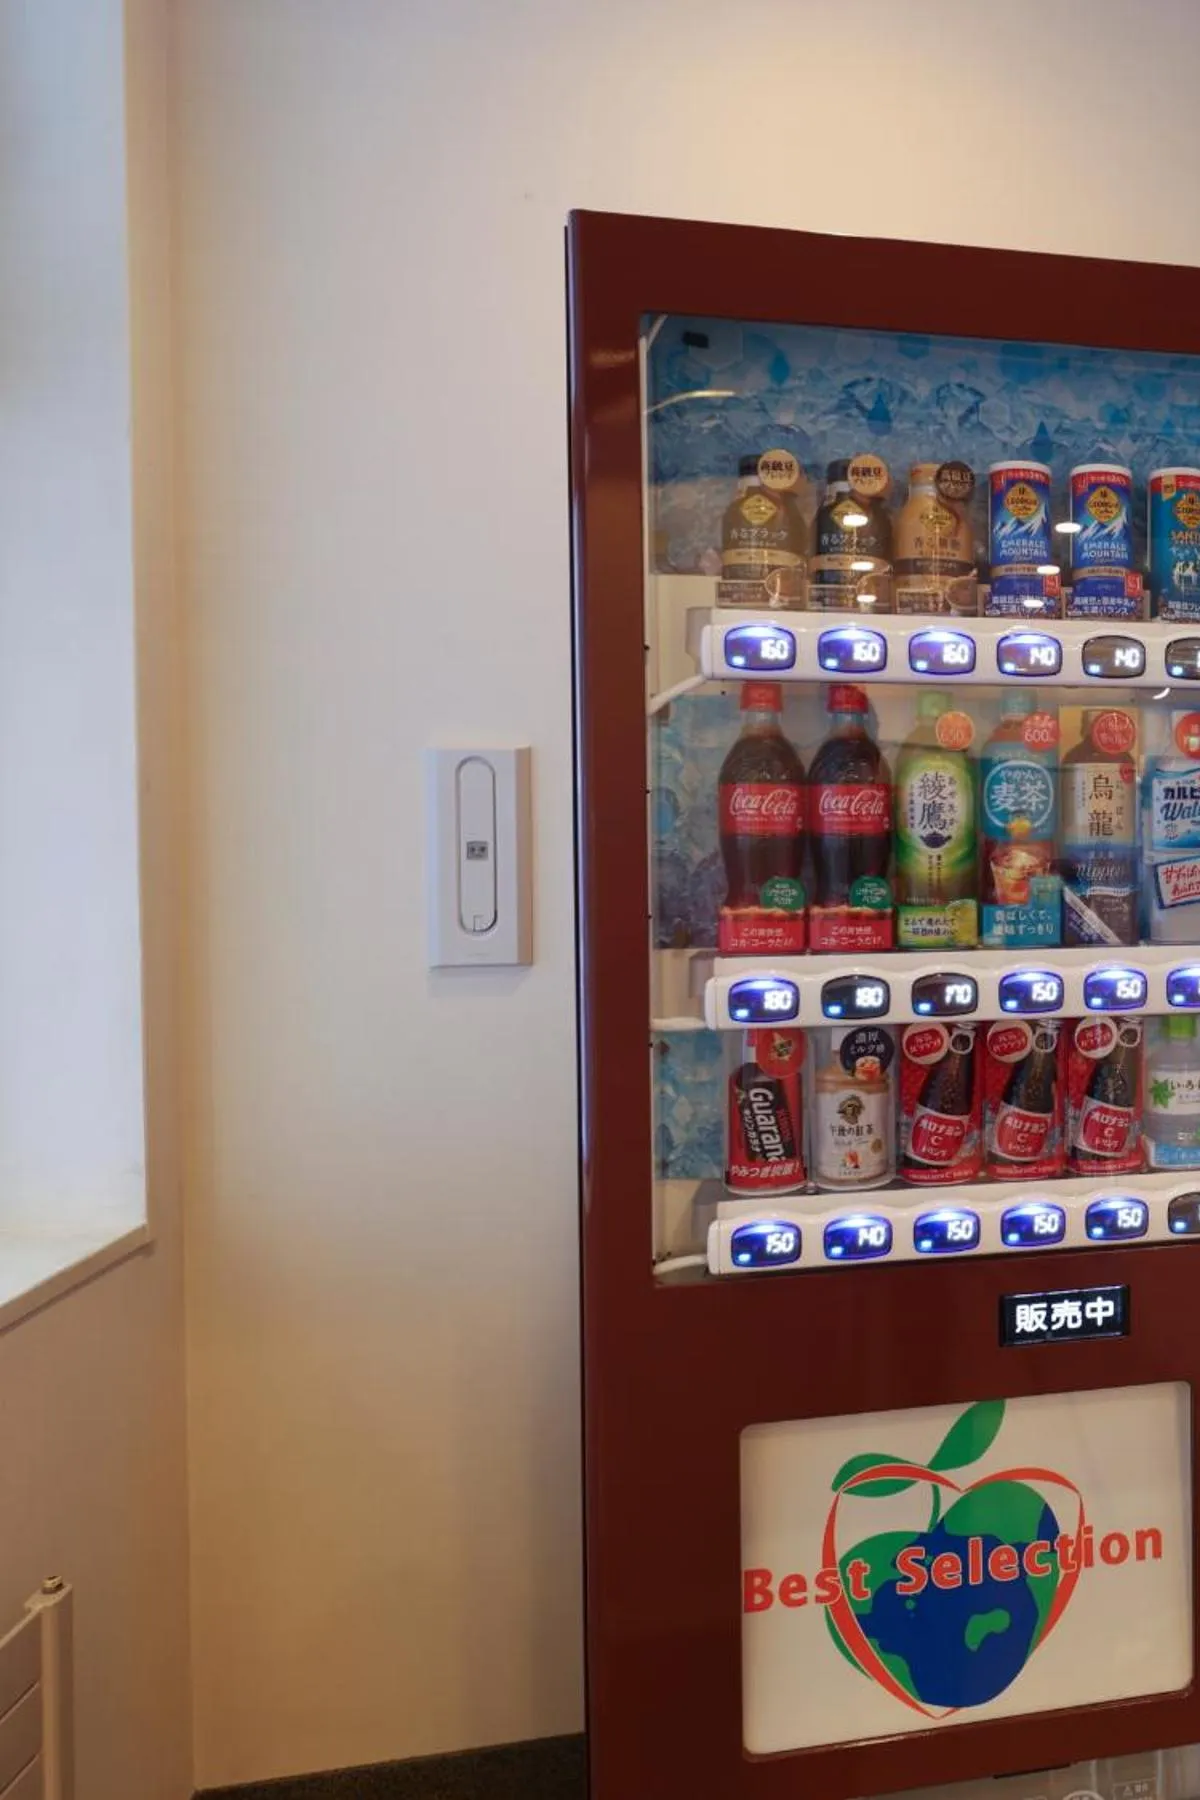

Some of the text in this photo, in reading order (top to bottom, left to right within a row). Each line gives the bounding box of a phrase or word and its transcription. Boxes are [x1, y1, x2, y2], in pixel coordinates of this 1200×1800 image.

[1001, 540, 1046, 550] EMERALD
[1083, 542, 1128, 551] EMERALD
[1030, 646, 1055, 666] 140
[1115, 648, 1140, 668] 140
[729, 787, 797, 817] Coca-Cola
[818, 788, 886, 817] Coca-Cola
[918, 771, 949, 831] 綾鷹
[990, 781, 1049, 813] 麦茶
[1088, 773, 1114, 838] 烏龍
[764, 990, 793, 1010] 180
[856, 987, 884, 1007] 180
[946, 984, 972, 1004] 170
[919, 1119, 964, 1137] オロナミン
[1004, 1115, 1048, 1135] オロナミン
[1089, 1110, 1131, 1129] オロナミン
[930, 1134, 943, 1147] C
[1016, 1132, 1029, 1144] C
[1103, 1127, 1116, 1138] C
[1034, 1213, 1058, 1233] 150
[1118, 1208, 1143, 1228] 150
[859, 1225, 886, 1246] 140
[948, 1220, 973, 1240] 150
[767, 1232, 794, 1253] 150
[1014, 1295, 1115, 1334] 販売中
[742, 1524, 1164, 1615] Best Selection
